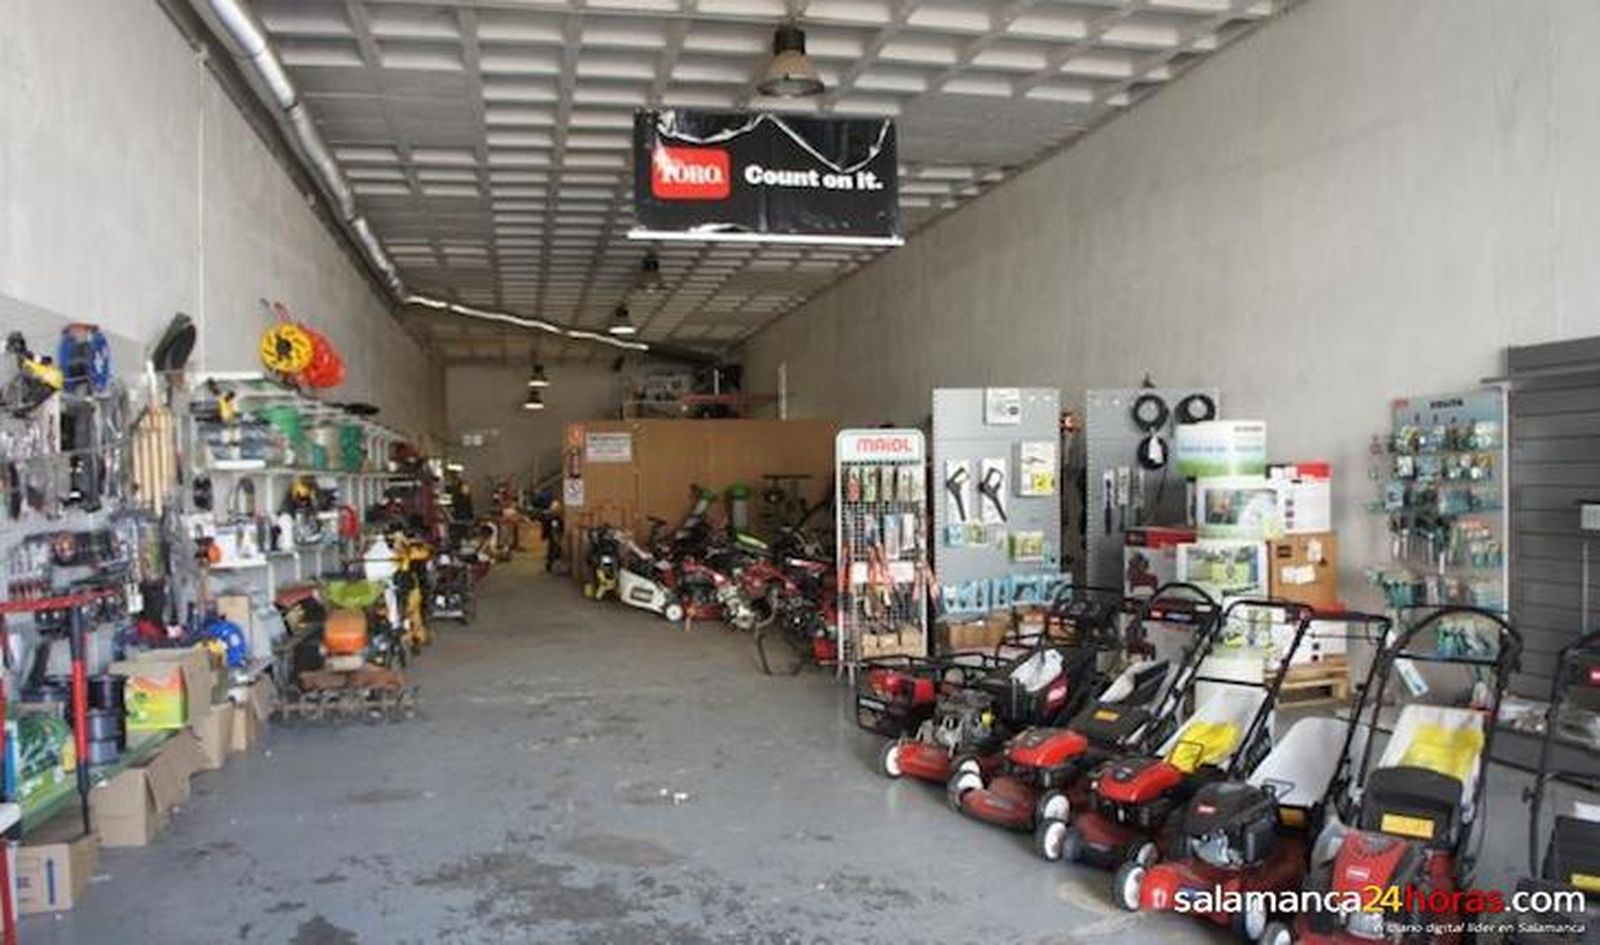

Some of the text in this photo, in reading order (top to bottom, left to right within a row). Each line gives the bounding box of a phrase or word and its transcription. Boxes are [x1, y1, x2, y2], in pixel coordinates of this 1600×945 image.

[661, 161, 723, 184] TORO
[744, 165, 883, 190] Count on it.
